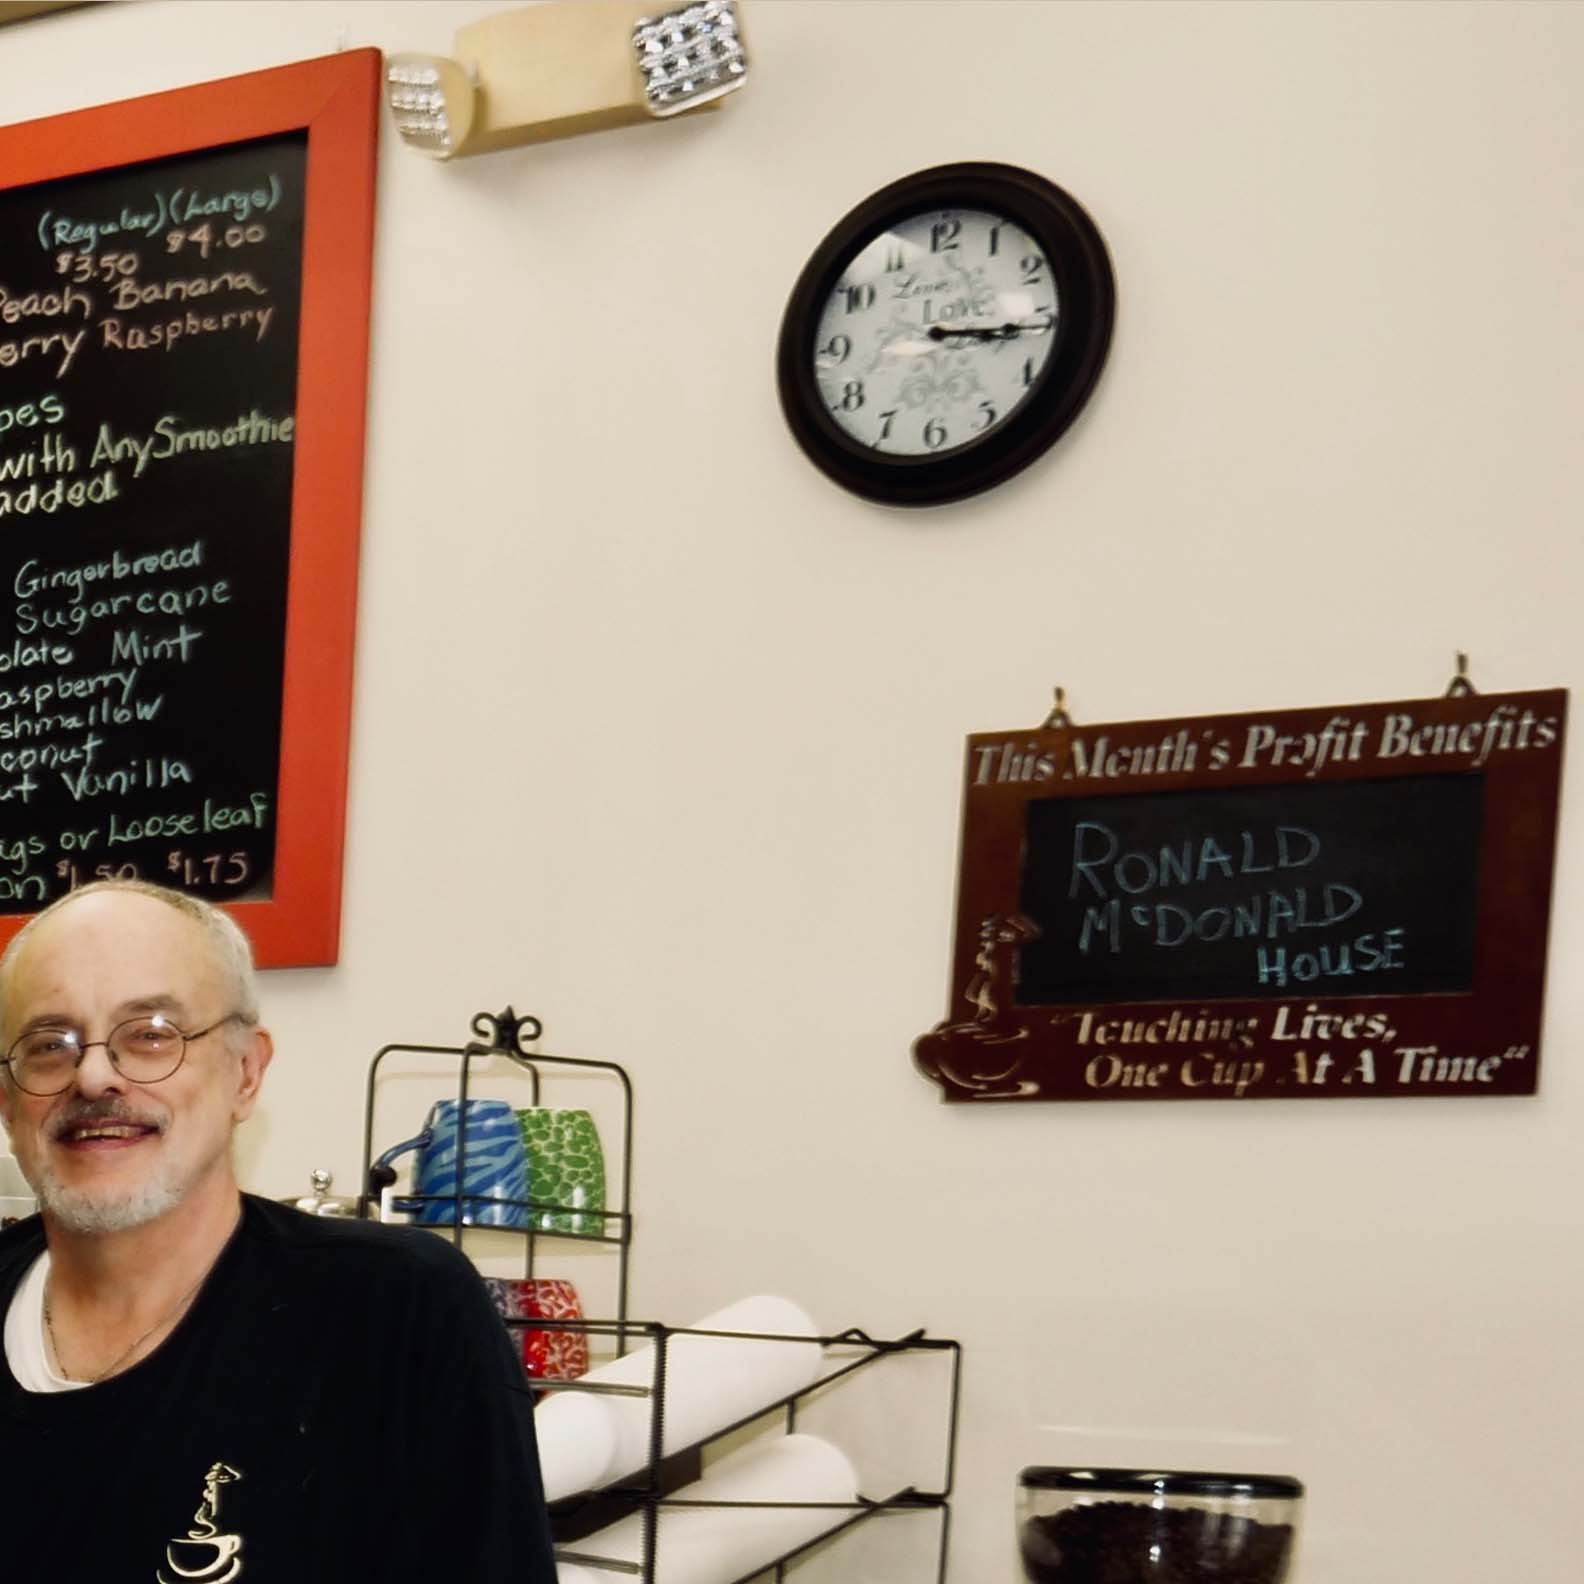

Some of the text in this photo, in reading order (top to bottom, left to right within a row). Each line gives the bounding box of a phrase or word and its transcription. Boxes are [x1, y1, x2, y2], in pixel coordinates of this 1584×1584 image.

[37, 174, 283, 250] (Regular) (Large)
[56, 252, 139, 283] $3.50
[166, 224, 266, 258] $4.00
[930, 219, 961, 253] 12
[1020, 255, 1043, 285] 2
[110, 273, 268, 311] Banana
[839, 283, 875, 314] 10
[99, 306, 275, 352] Raspberry
[819, 335, 850, 365] 9
[833, 381, 865, 411] 8
[878, 410, 898, 440] 7
[923, 418, 947, 448] 6
[91, 424, 156, 479] Any
[153, 412, 294, 460] Smoothie
[15, 541, 202, 601] Gingerbread
[111, 630, 202, 665] Mint
[972, 706, 1558, 785] This Month's Profit Benefits
[61, 760, 193, 800] Vanilla
[60, 830, 99, 855] or
[107, 812, 200, 843] Loose
[167, 850, 248, 885] $1.75
[1069, 821, 1321, 897] RONALD
[1257, 929, 1406, 986] HOUSE
[1270, 1005, 1398, 1042] Lives,
[1084, 1054, 1168, 1089] One
[1180, 1052, 1264, 1095] Cup
[1277, 1051, 1333, 1084] At
[1342, 1048, 1375, 1083] A
